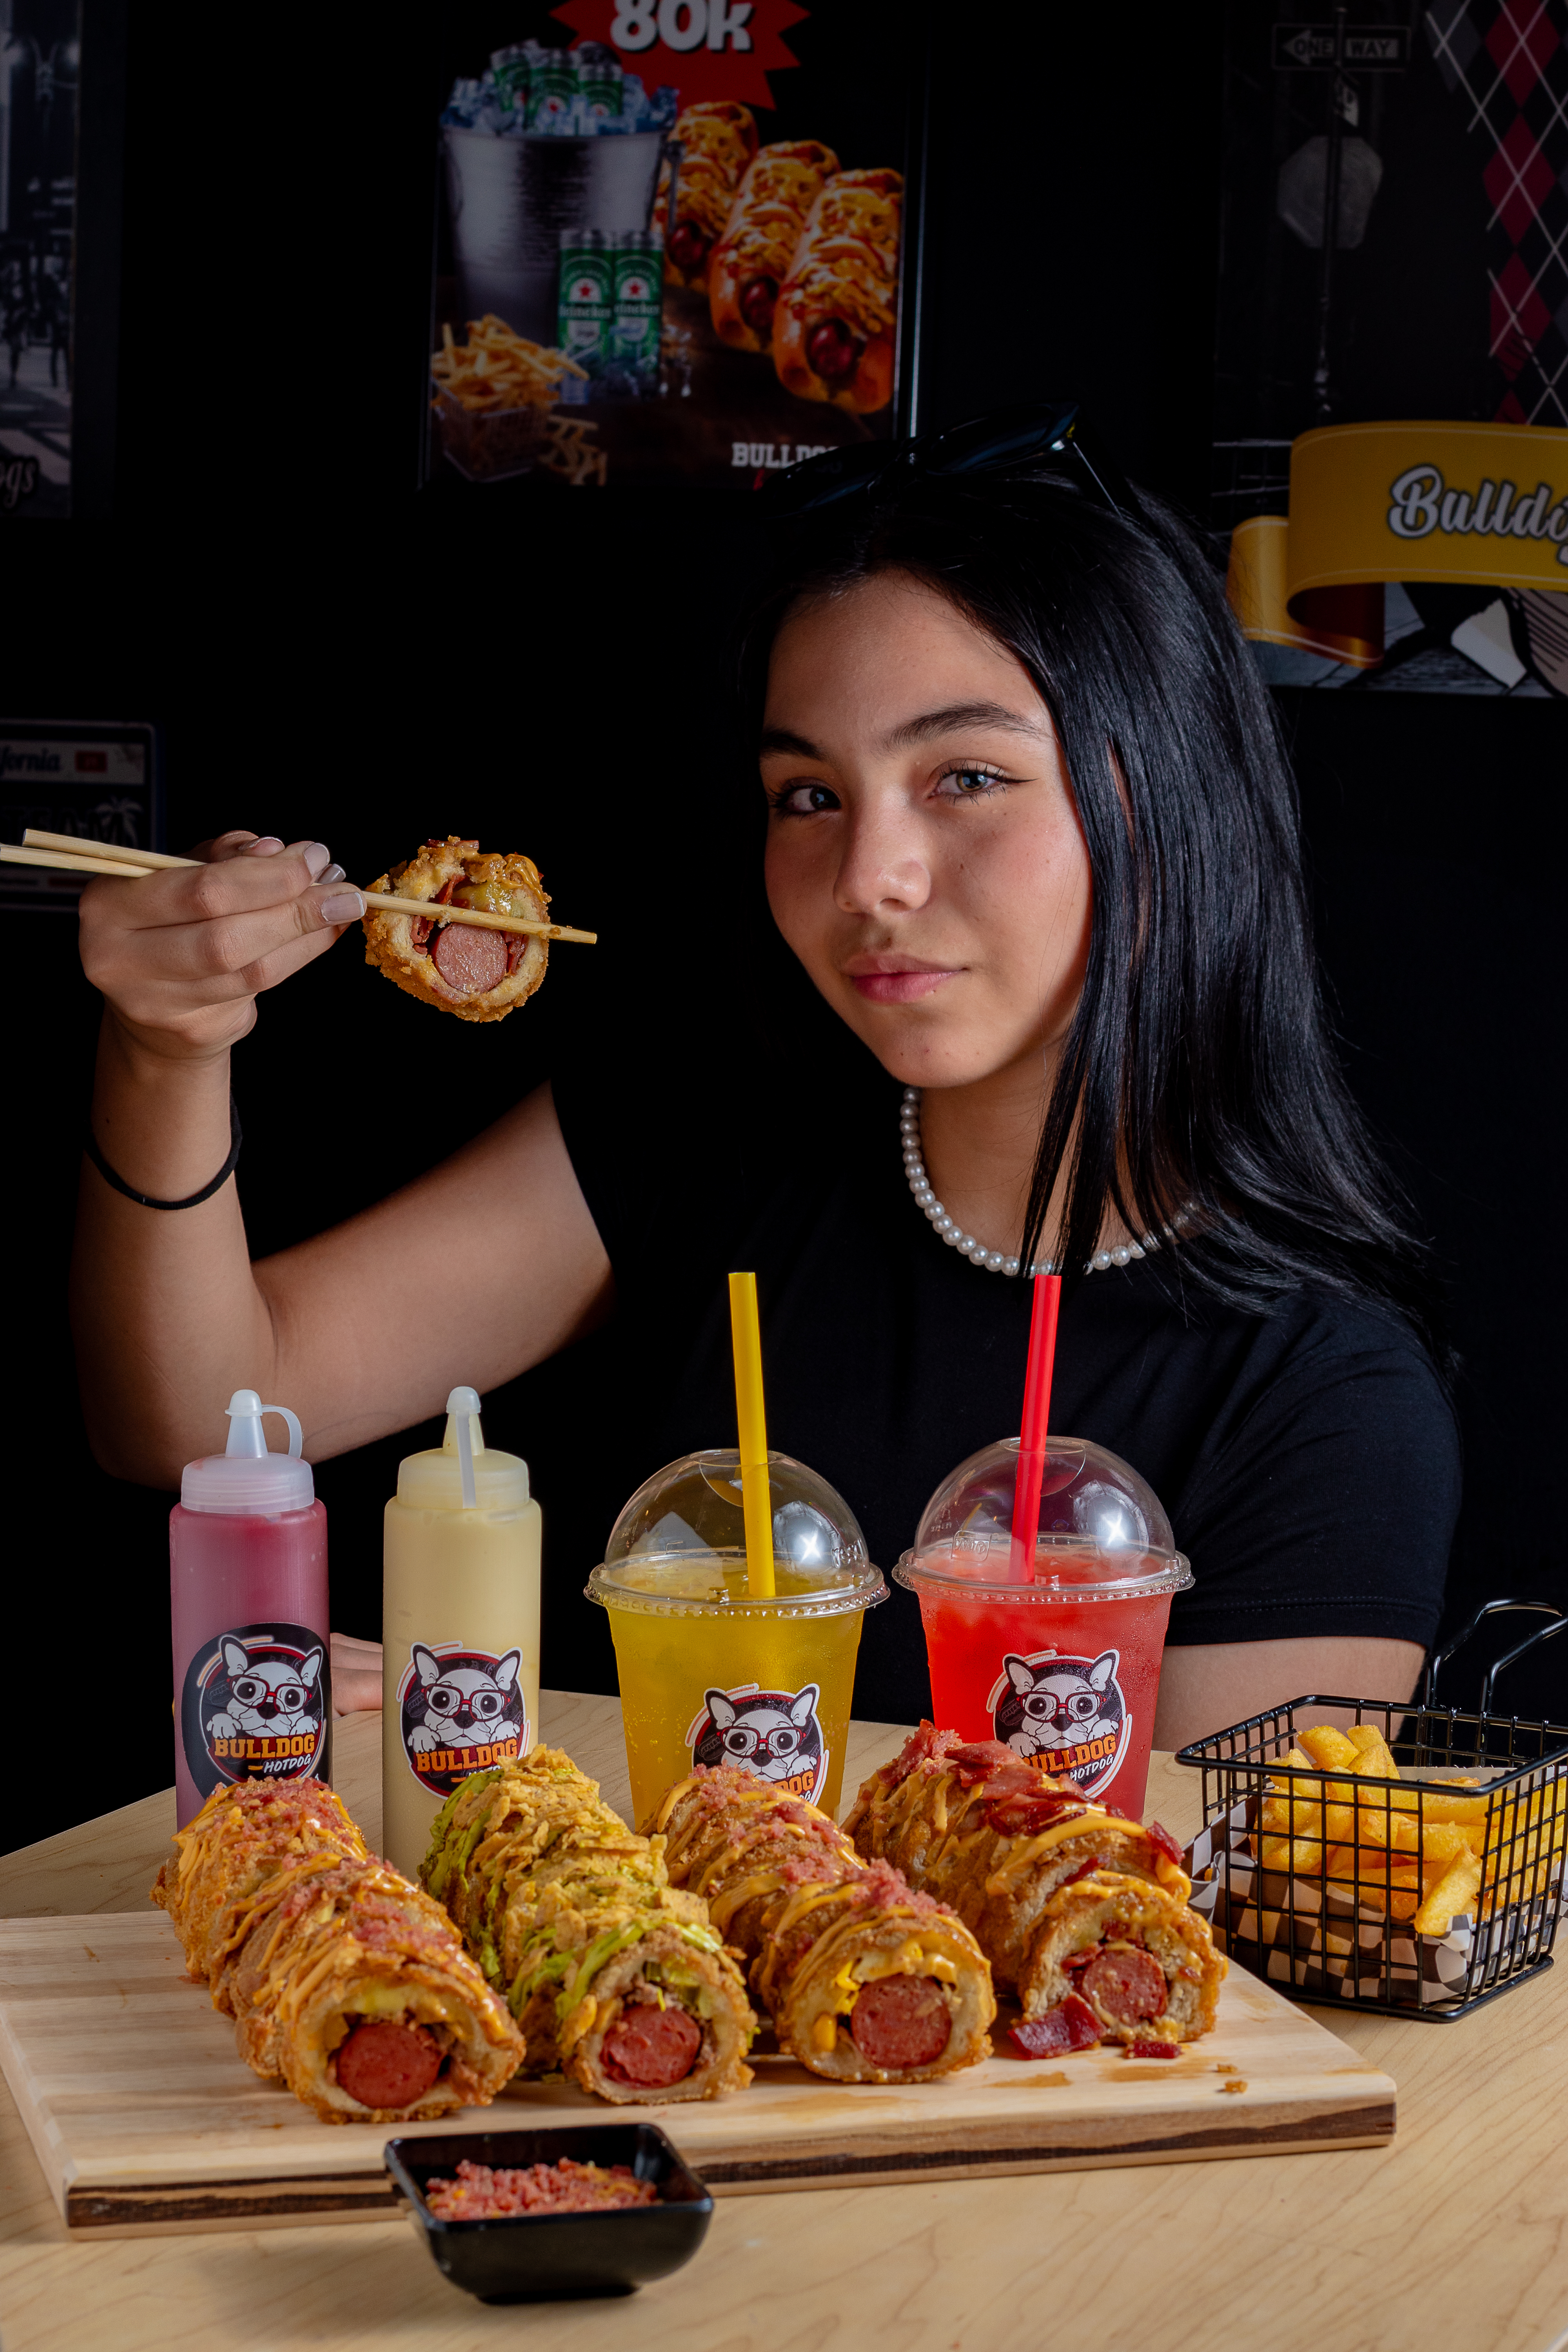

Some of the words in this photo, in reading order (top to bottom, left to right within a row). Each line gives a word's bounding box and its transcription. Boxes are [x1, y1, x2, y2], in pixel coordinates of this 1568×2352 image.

[610, 0, 752, 51] 80k
[1350, 38, 1391, 57] WAY
[731, 442, 839, 469] BULLD
[1388, 464, 1568, 566] Bulldo
[214, 1734, 314, 1759] BULLDOG
[416, 1739, 517, 1771] BULLDOG
[263, 1753, 312, 1773] HOTDOG
[1070, 1754, 1114, 1781] HOTDOG
